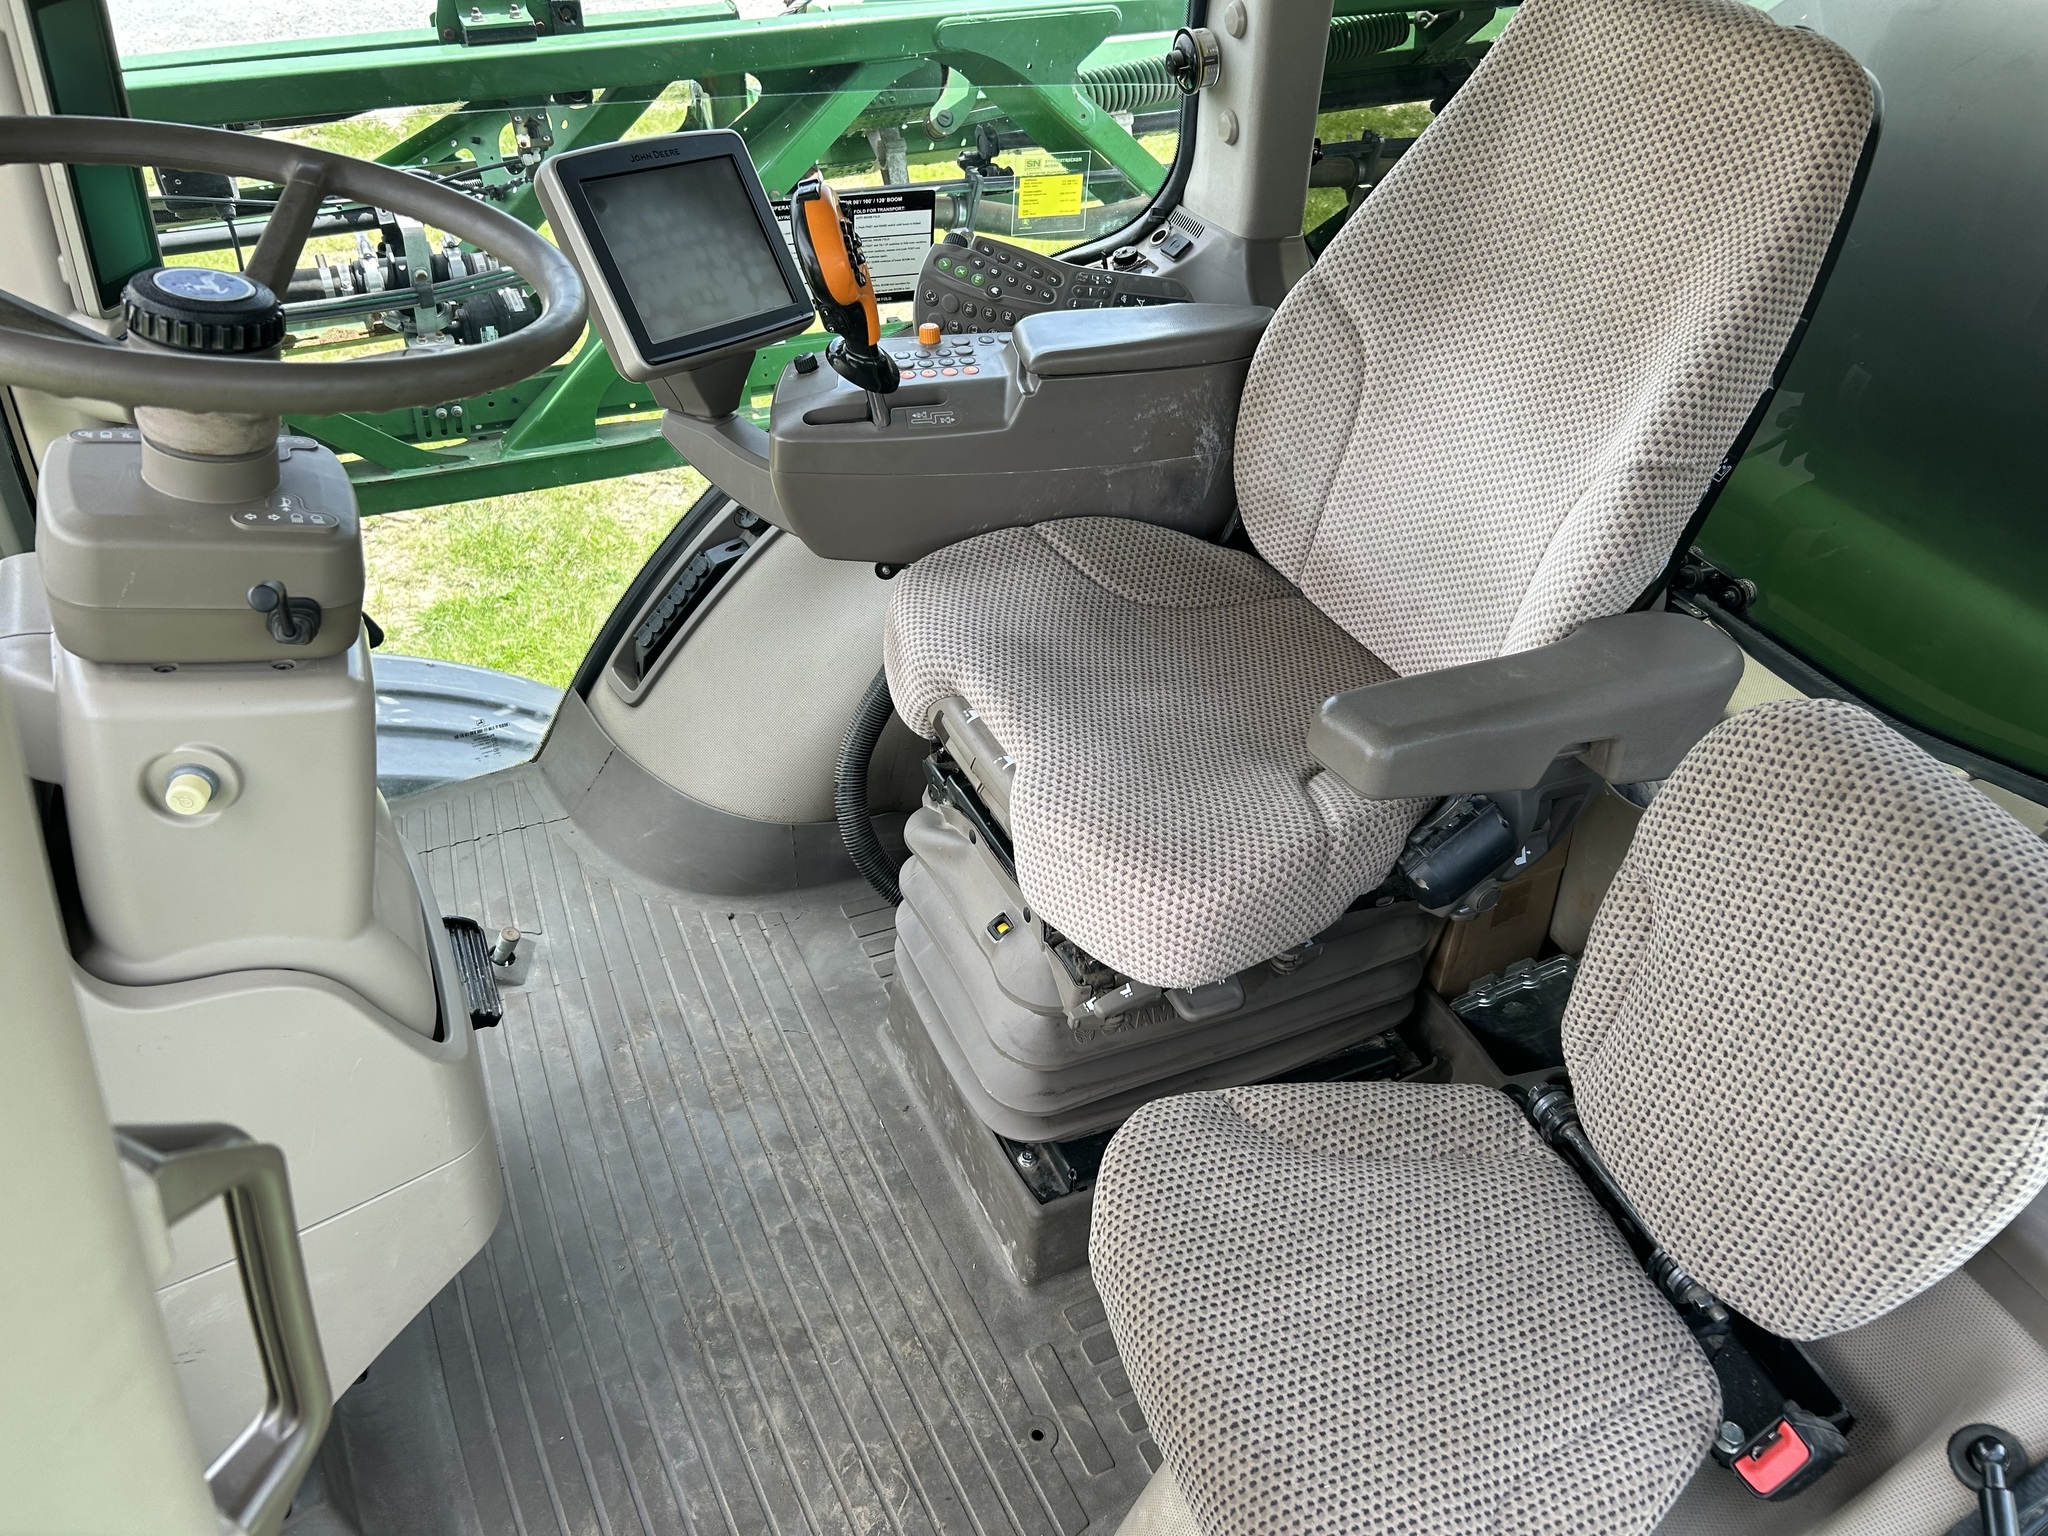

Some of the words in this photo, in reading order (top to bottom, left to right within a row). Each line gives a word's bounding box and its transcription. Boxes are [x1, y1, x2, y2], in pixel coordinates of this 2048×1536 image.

[631, 153, 653, 163] JOHN
[652, 148, 681, 159] DEERE
[1026, 160, 1041, 168] SN
